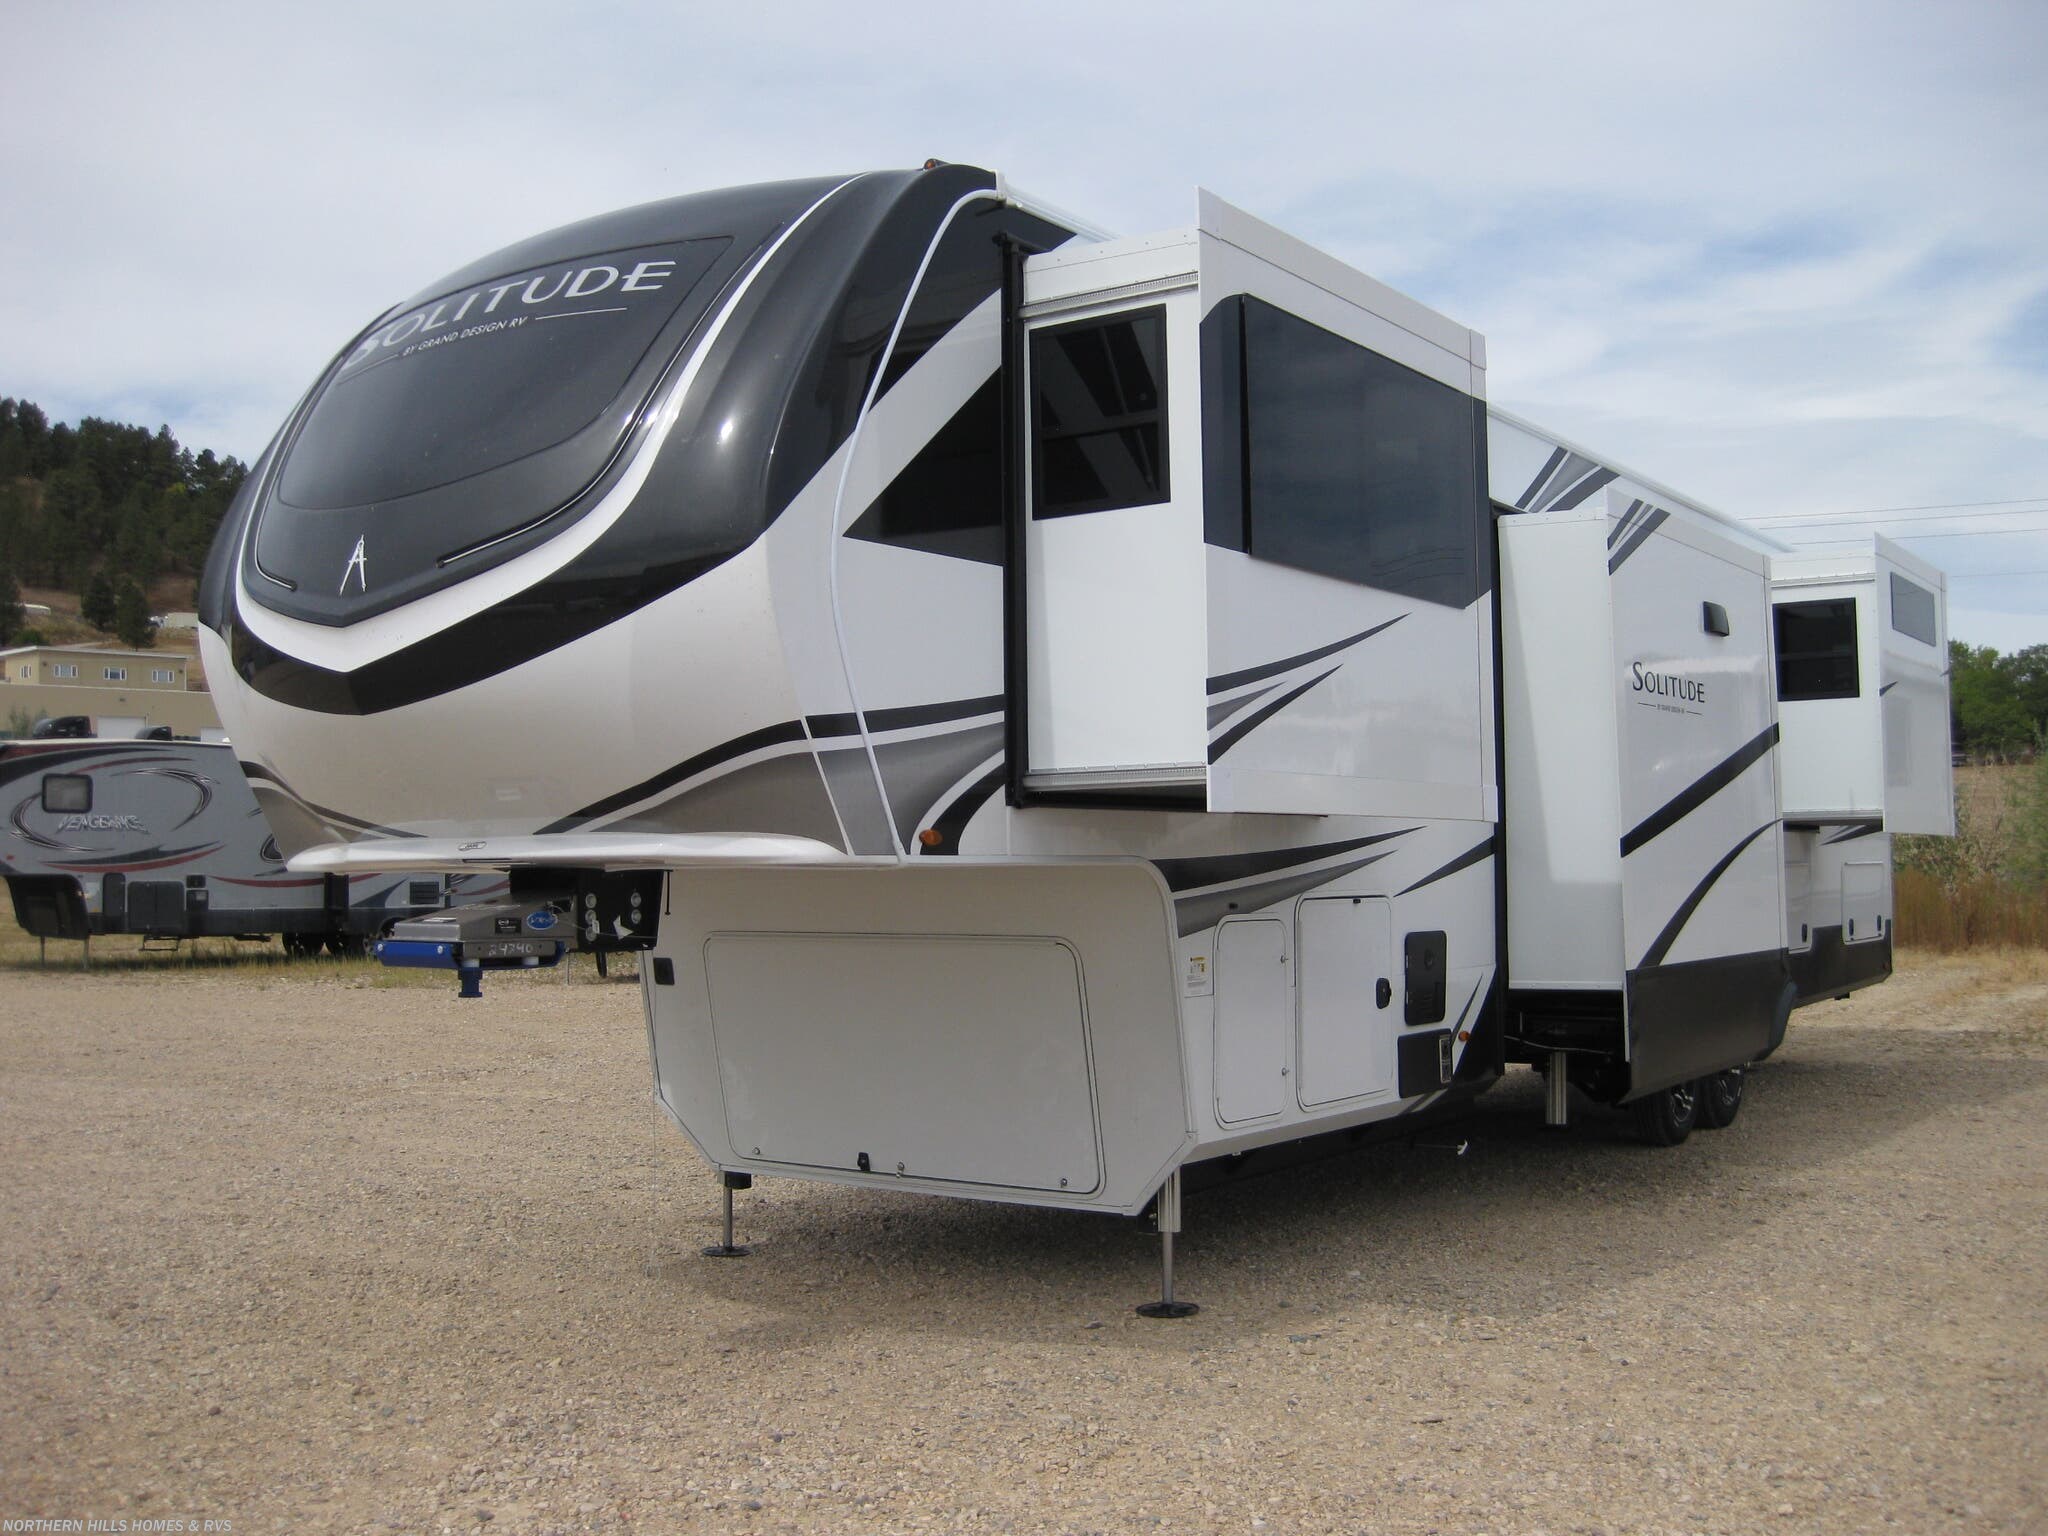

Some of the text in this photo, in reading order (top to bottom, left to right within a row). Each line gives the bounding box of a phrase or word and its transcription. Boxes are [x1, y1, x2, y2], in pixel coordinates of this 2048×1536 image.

[341, 260, 677, 371] SOLITUDE
[403, 315, 529, 357] BY GRAND DESIGN RV
[1632, 660, 1706, 704] SOLITUDE
